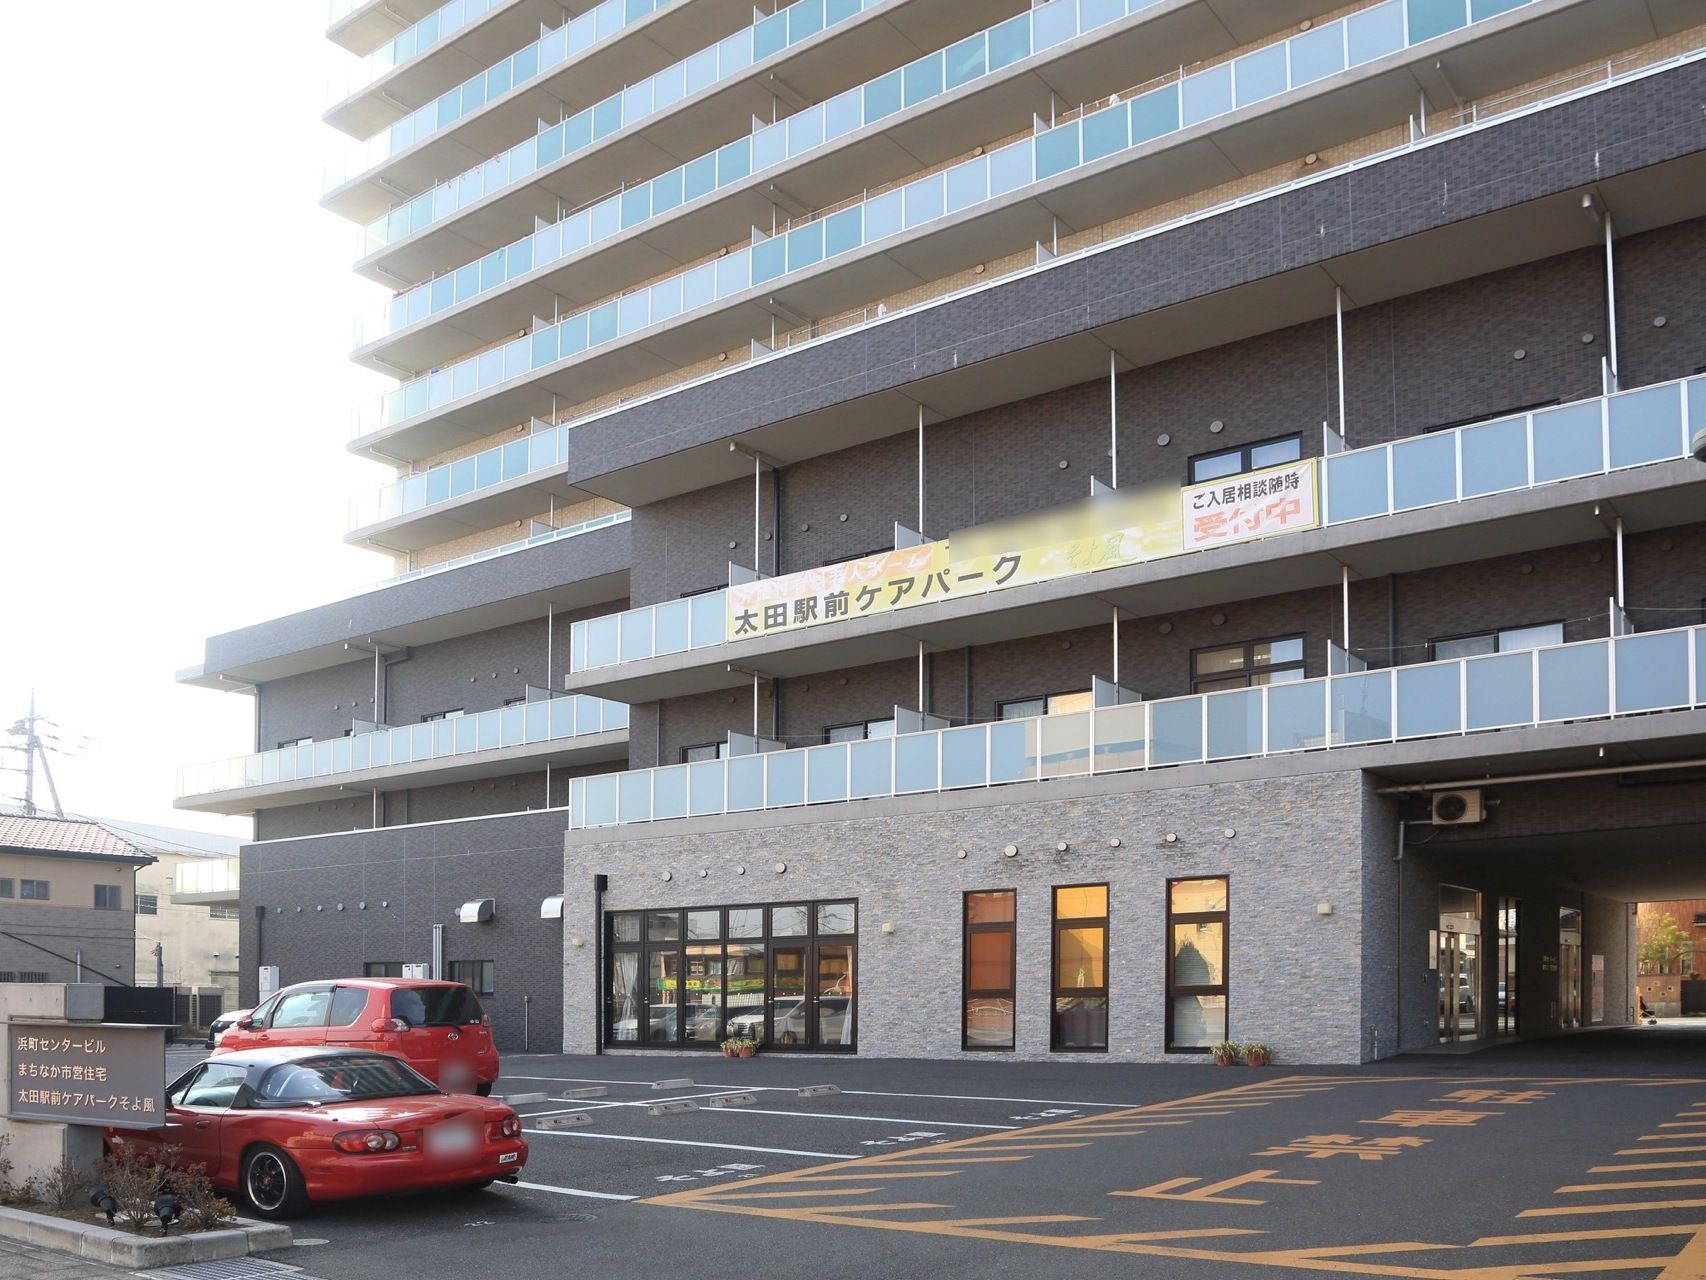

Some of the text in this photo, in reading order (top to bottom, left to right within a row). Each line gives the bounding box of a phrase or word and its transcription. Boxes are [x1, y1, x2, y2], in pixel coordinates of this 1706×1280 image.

[1192, 472, 1300, 510] ご入居相談随時
[1193, 496, 1302, 542] 受付中
[734, 555, 1021, 635] 太田駅前ケアパーク
[18, 1036, 106, 1054] 浜町センタービル
[18, 1062, 107, 1082] まちなか市営住宅
[18, 1088, 156, 1112] 太田駅前ケアパークそよ風
